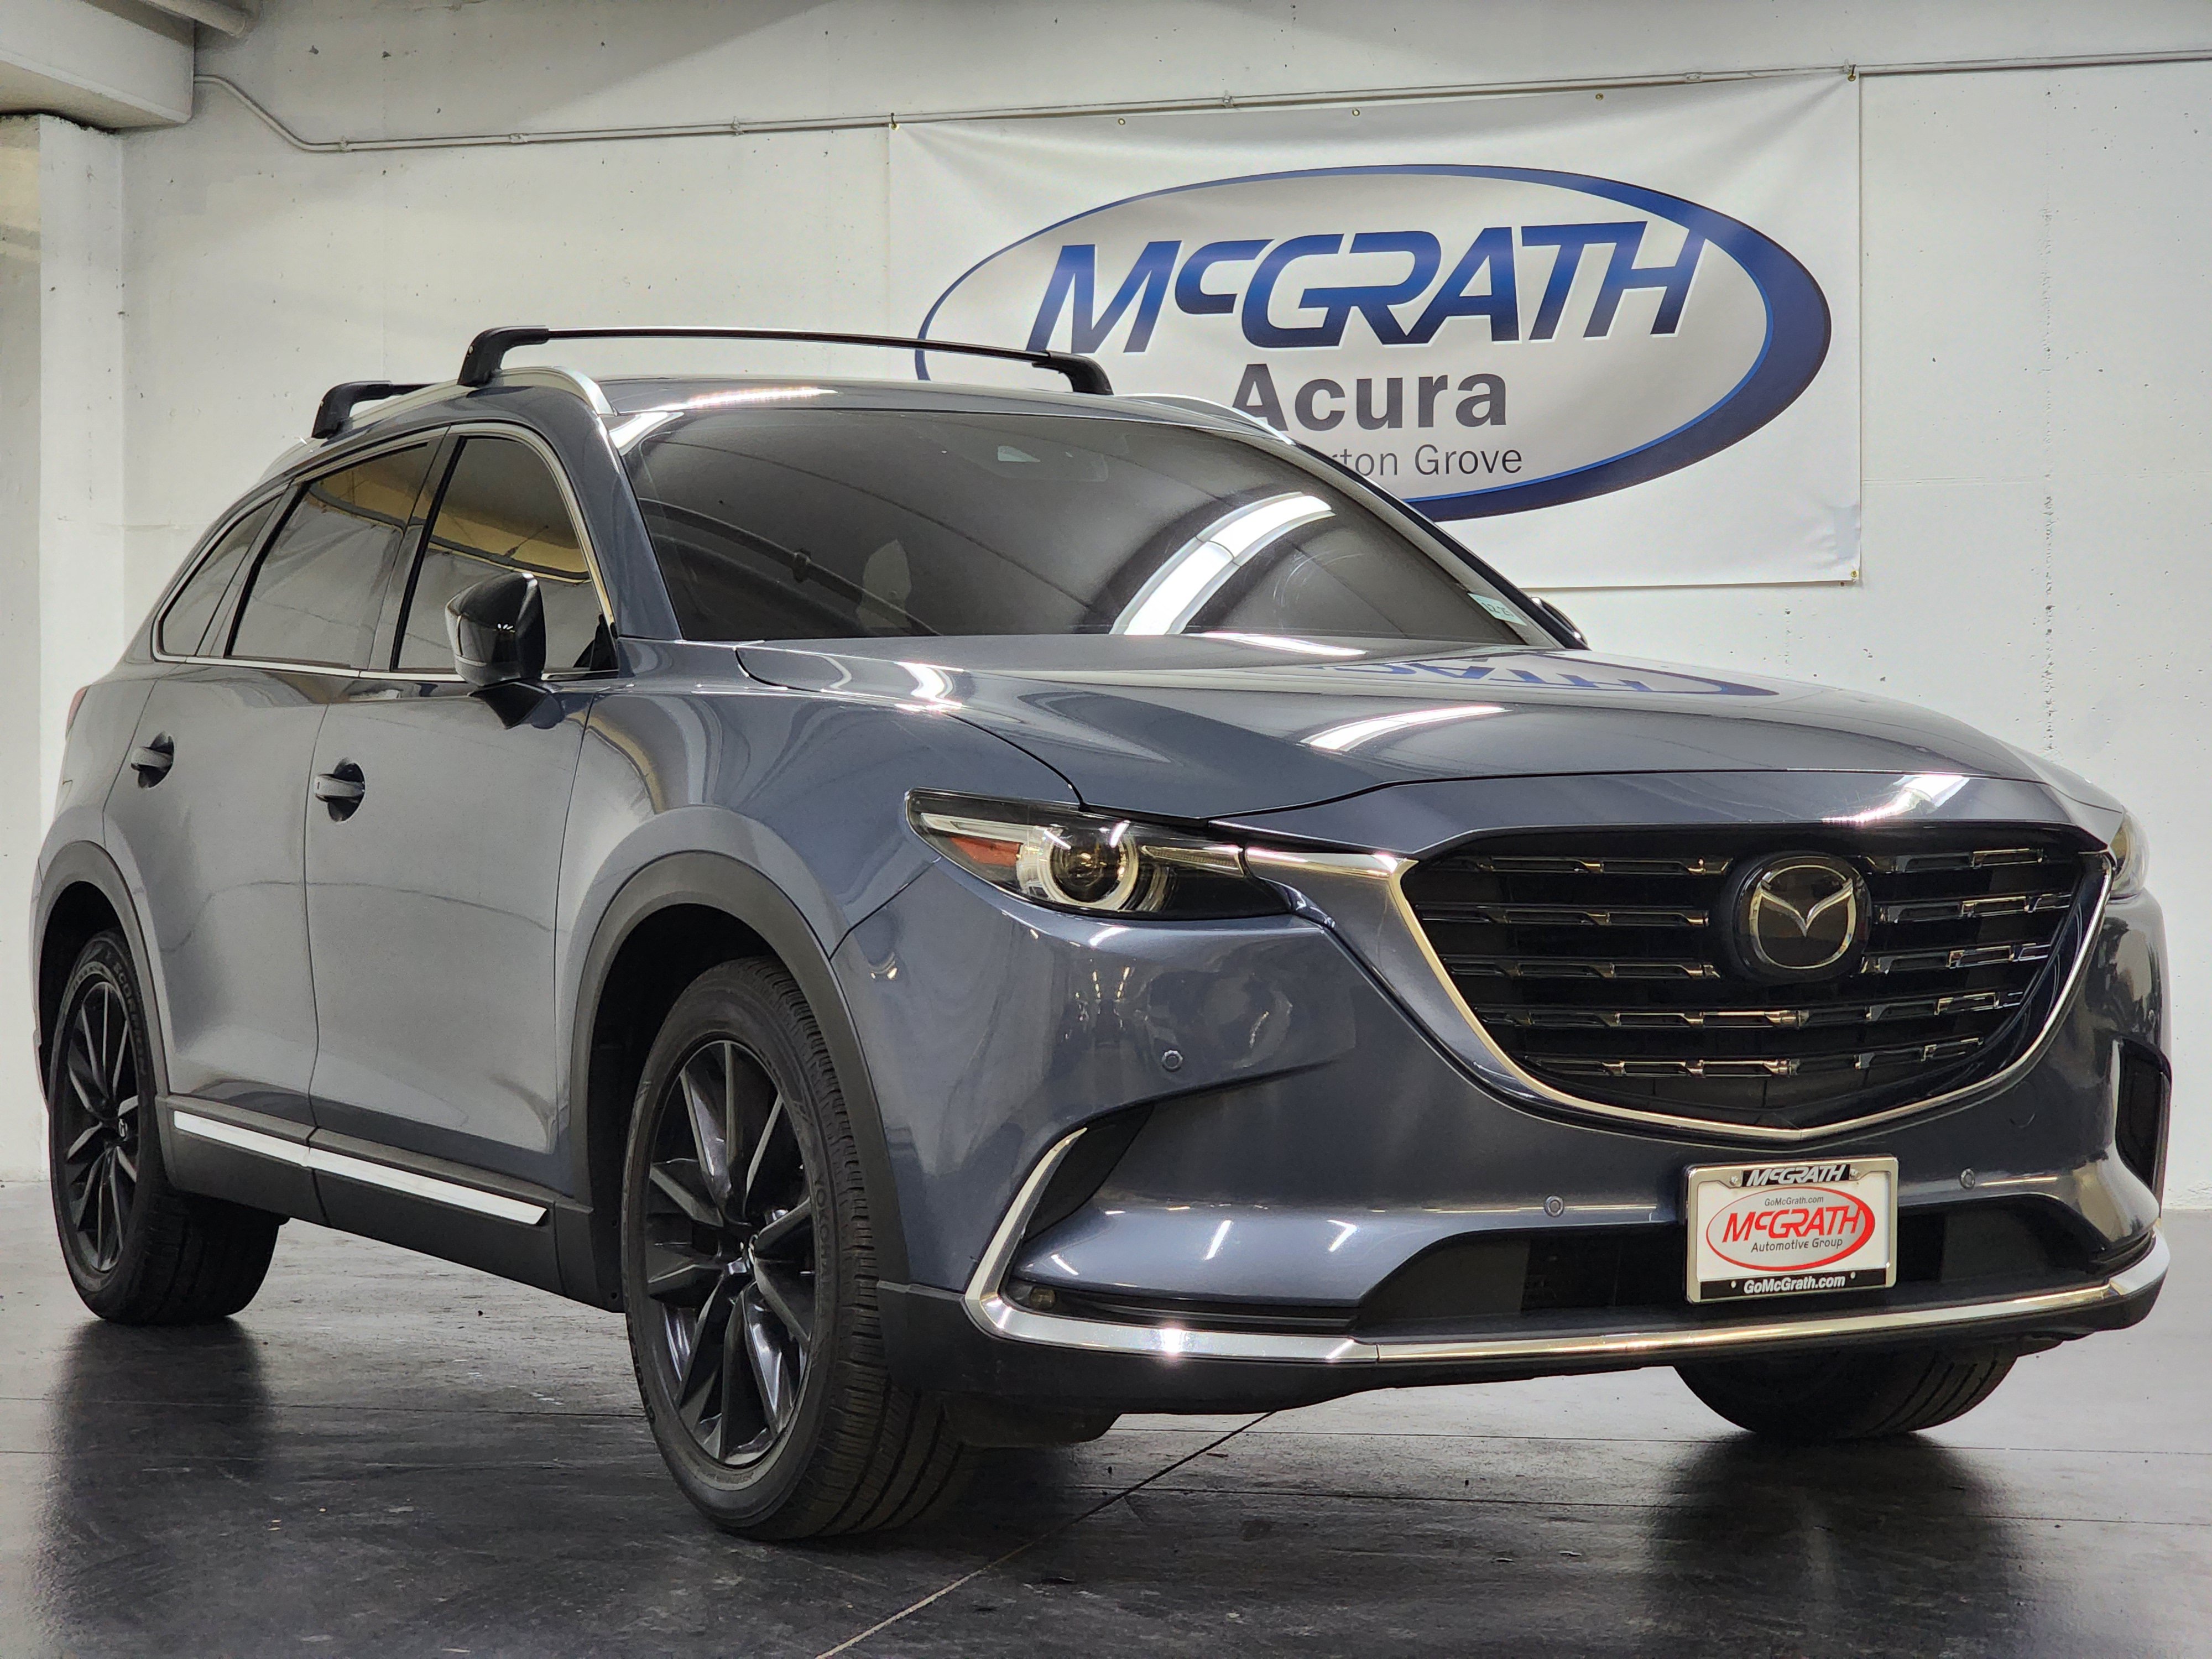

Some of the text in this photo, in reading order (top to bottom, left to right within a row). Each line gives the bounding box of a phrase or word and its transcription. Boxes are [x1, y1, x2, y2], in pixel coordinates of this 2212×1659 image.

[1232, 363, 1507, 431] Acura
[1332, 444, 1522, 476] ton Grove
[1764, 1195, 1824, 1207] GoMcGrath.com
[1751, 1238, 1843, 1253] Automotive Group
[1743, 1275, 1846, 1294] GoMcGrath.com
